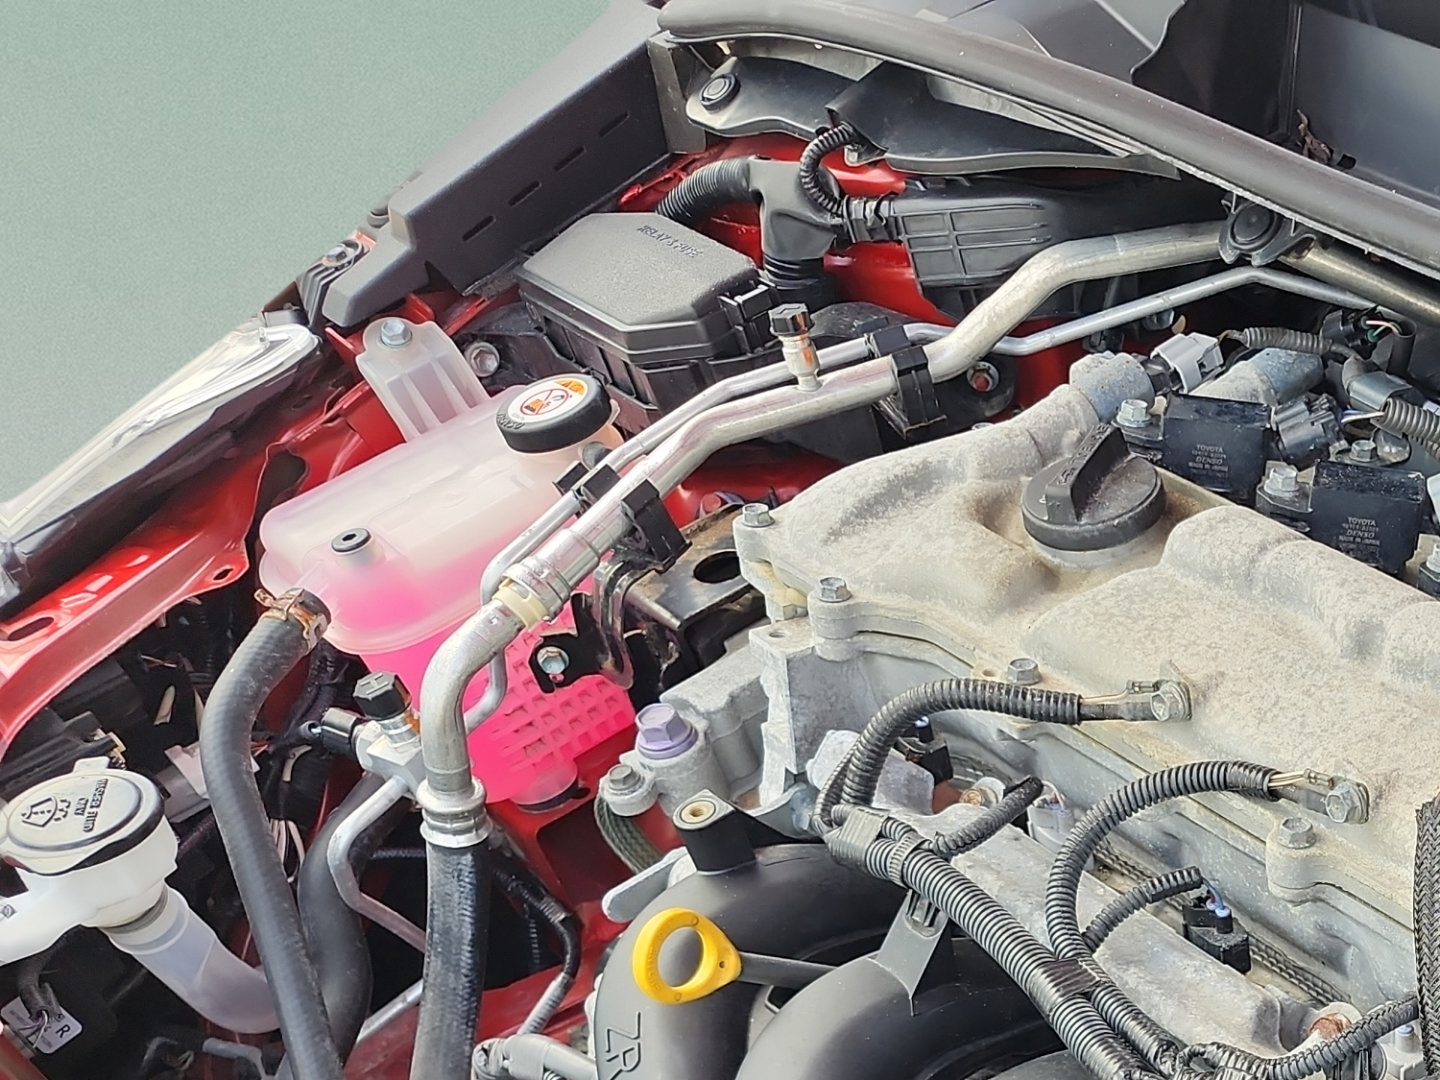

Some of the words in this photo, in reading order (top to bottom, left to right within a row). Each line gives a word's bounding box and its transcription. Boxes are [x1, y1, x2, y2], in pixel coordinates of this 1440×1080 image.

[1196, 444, 1223, 453] TOYOTA
[1195, 456, 1223, 465] DENSO
[1348, 517, 1376, 526] TOYOTA
[1346, 529, 1375, 538] DENSO
[56, 1023, 70, 1039] R
